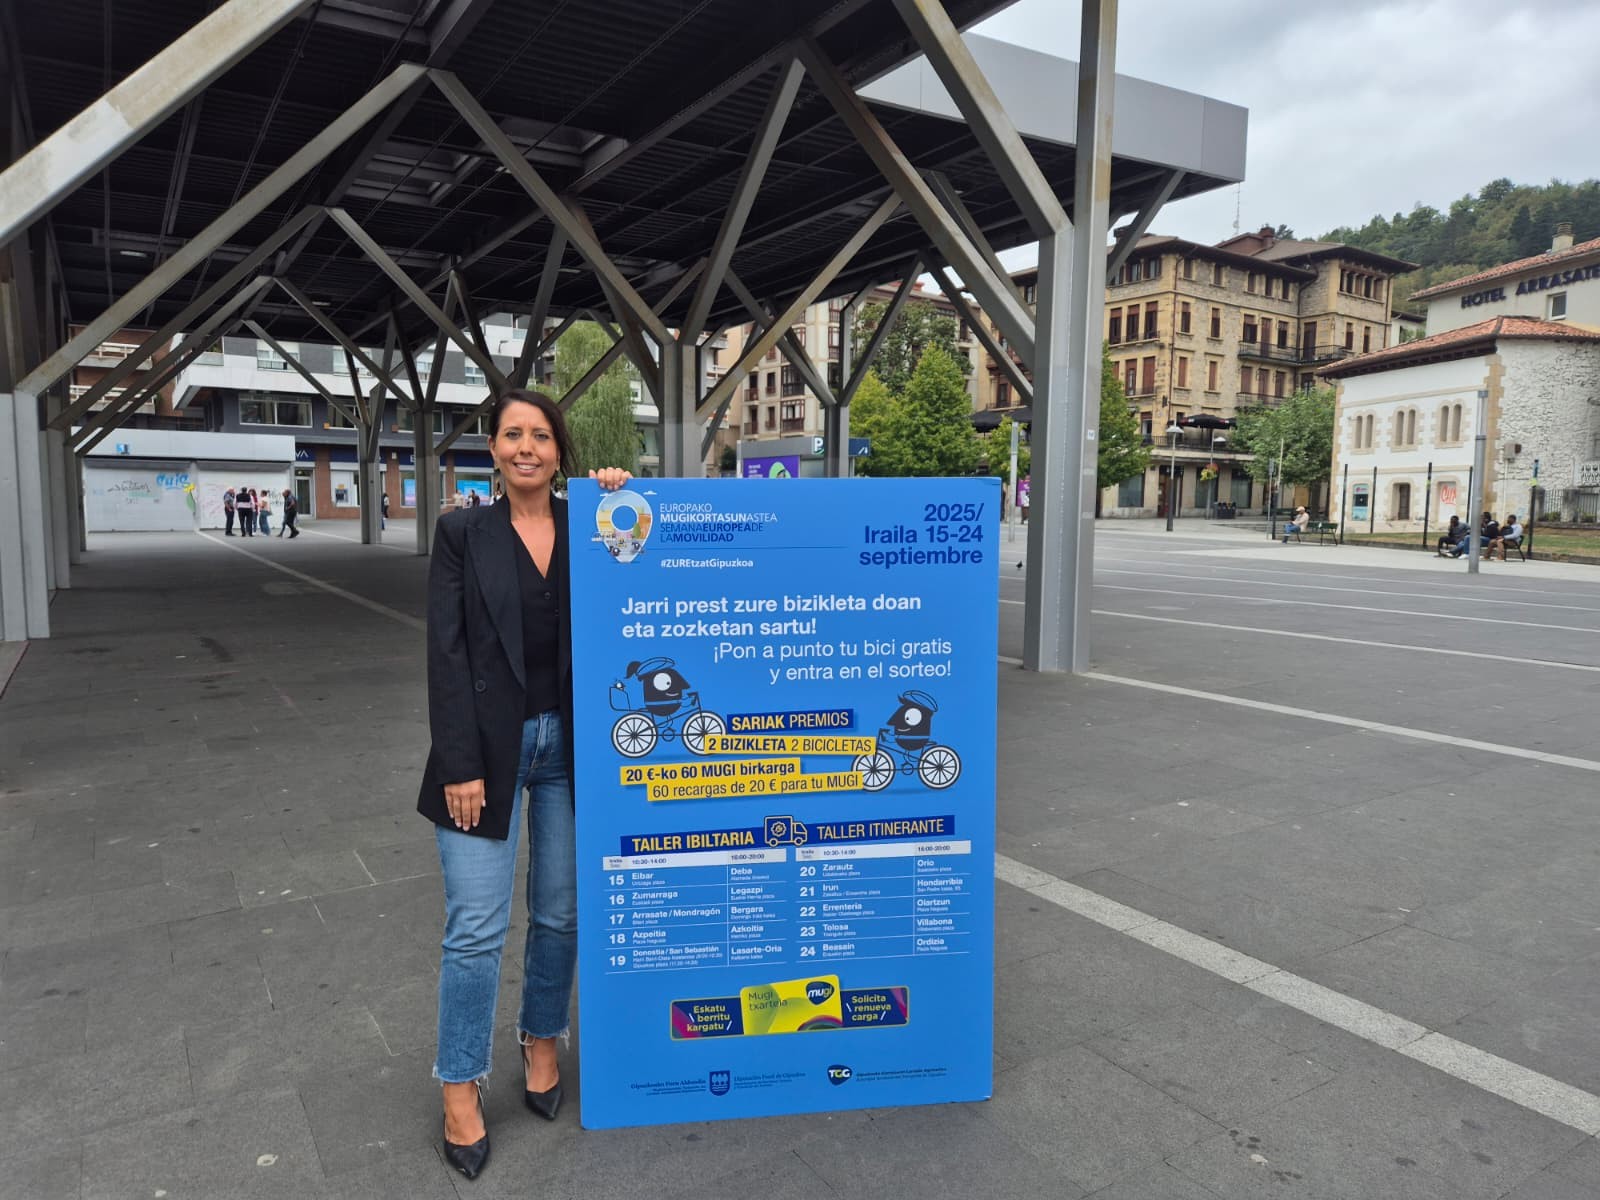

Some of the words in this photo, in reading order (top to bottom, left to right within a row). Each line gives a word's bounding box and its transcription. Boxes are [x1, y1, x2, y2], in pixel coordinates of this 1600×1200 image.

[1461, 287, 1506, 309] HOTEL
[659, 503, 713, 514] EUROPAKO
[659, 512, 778, 524] MUGIKORTASUNASTEA
[923, 502, 985, 522] 2025/
[864, 525, 918, 545] Iraila
[925, 524, 984, 544] 15-24
[660, 557, 755, 570] #ZUREtzatGipuzkoa
[859, 546, 984, 569] septiembre
[621, 597, 670, 616] Jarri
[675, 597, 729, 618] prest
[733, 598, 778, 614] zure
[783, 593, 867, 613] bizikleta
[872, 594, 922, 612] doan
[621, 621, 656, 638] eta
[661, 618, 754, 638] zozketan
[759, 617, 817, 636] sartu!
[713, 641, 756, 663] ¡Pon
[762, 645, 775, 659] a
[779, 642, 834, 662] punto
[839, 640, 858, 657] tu
[864, 638, 896, 657] bici
[901, 637, 952, 660] gratis
[769, 667, 781, 685] y
[785, 664, 834, 681] entra
[839, 665, 863, 680] en
[867, 661, 884, 679] el
[888, 659, 952, 679] sorteo!
[731, 714, 785, 732] SARIAK
[789, 711, 849, 729] PREMIOS
[708, 737, 718, 751] 2
[720, 737, 786, 752] BIZIKLETA
[791, 737, 800, 752] 2
[802, 737, 872, 752] BICICLETAS
[625, 768, 643, 782] 20
[646, 765, 677, 780] €-ko
[681, 764, 698, 779] 60
[701, 762, 736, 778] MUGI
[740, 760, 795, 778] birkarga
[652, 784, 670, 798] 60
[673, 781, 727, 799] recargas
[730, 779, 745, 794] de
[750, 779, 765, 793] 20
[769, 778, 777, 792] €
[780, 777, 808, 794] para
[811, 775, 823, 790] tu
[827, 773, 858, 789] MUGI
[817, 823, 866, 841] TALLER
[869, 818, 945, 837] ITINERANTE
[632, 835, 683, 853] TAILER
[686, 831, 755, 850] IBILTARIA
[608, 874, 625, 886] 15
[632, 872, 654, 880] Eibar
[731, 867, 753, 875] Deba
[799, 866, 816, 877] 20
[822, 863, 854, 872] Zarautz
[917, 859, 935, 867] Orio
[608, 894, 625, 906] 16
[632, 891, 679, 901] Zumarraga
[731, 886, 763, 896] Legazpi
[799, 886, 816, 897] 21
[608, 914, 625, 925] 17
[632, 910, 668, 920] Arrasate
[673, 907, 721, 918] Mondragón
[731, 905, 764, 915] Bergara
[799, 906, 816, 917] 22
[822, 902, 863, 911] Errenteria
[608, 934, 626, 945] 18
[731, 924, 764, 934] Azkoitia
[799, 926, 816, 937] 23
[822, 923, 849, 932] Tolosa
[917, 917, 953, 927] Villabona
[608, 955, 626, 966] 19
[731, 945, 783, 956] Lasarte-Oria
[799, 946, 816, 957] 24
[917, 937, 945, 947] Ordizia
[748, 990, 774, 1002] Mugi
[807, 985, 834, 999] mugi
[851, 994, 887, 1004] Solicita
[693, 1004, 726, 1014] Eskatu
[697, 1012, 730, 1023] berritu
[851, 1012, 878, 1023] carga
[854, 1003, 892, 1012] renueva
[686, 1022, 724, 1033] kargatu
